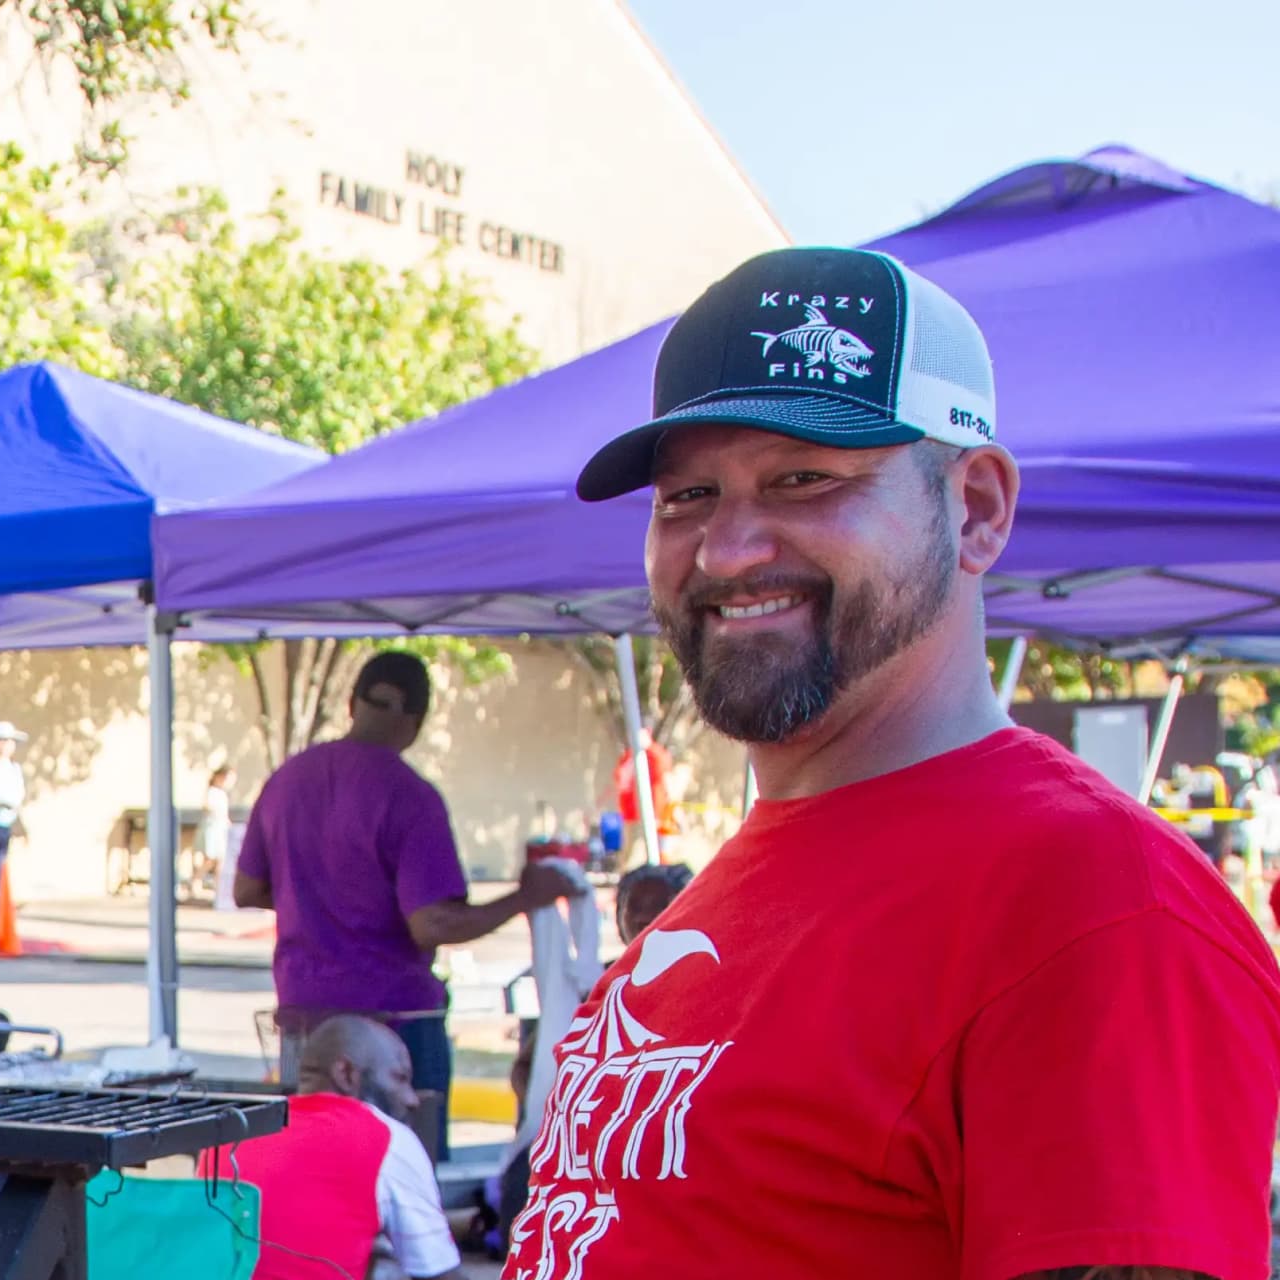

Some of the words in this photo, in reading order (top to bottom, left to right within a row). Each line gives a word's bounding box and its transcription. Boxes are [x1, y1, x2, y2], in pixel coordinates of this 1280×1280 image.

[405, 149, 464, 197] HOLY
[320, 171, 404, 225] FAMILY
[418, 201, 466, 245] LIFE
[478, 221, 564, 273] CENTER
[760, 291, 875, 314] Krazy
[768, 362, 849, 386] Fins
